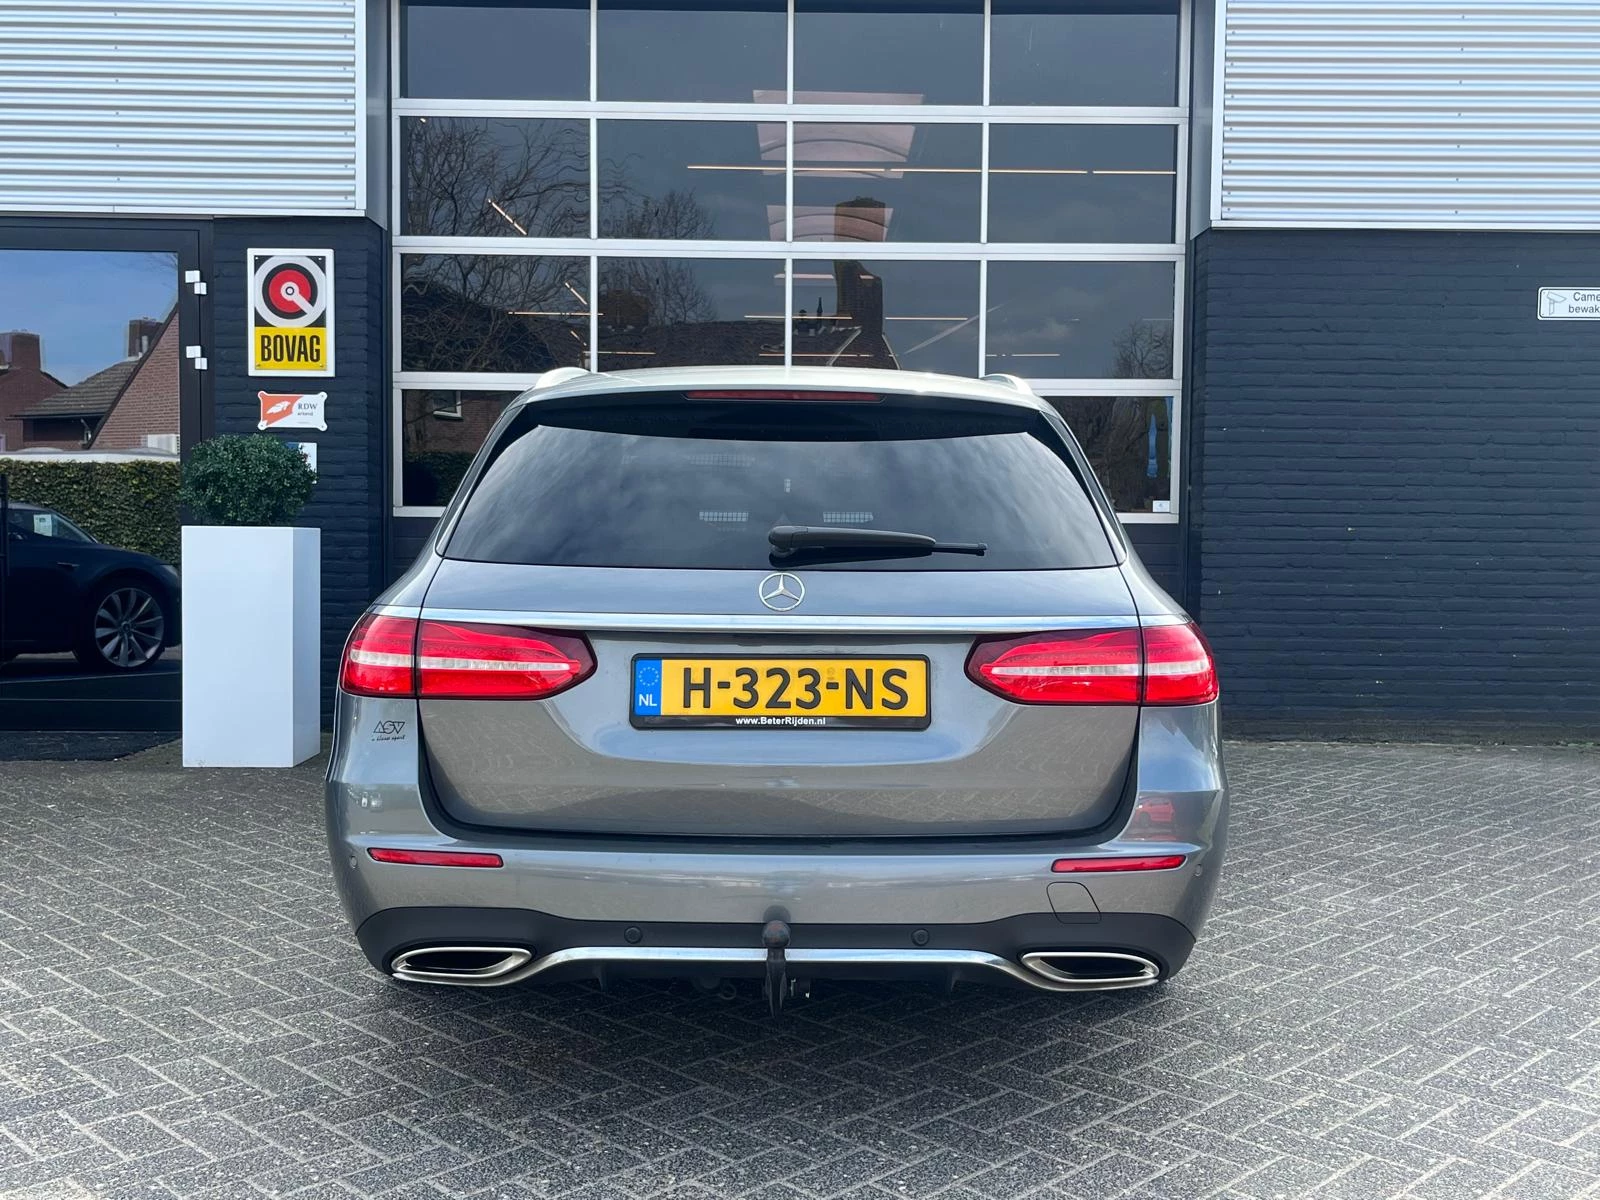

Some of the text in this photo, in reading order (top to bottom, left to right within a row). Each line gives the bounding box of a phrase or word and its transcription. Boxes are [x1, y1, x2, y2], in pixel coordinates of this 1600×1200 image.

[260, 334, 321, 363] BOVAG
[297, 402, 317, 410] RDW
[682, 667, 909, 710] H-323-NS
[638, 694, 657, 707] NL
[735, 717, 826, 727] www.BeterRijden.nl
